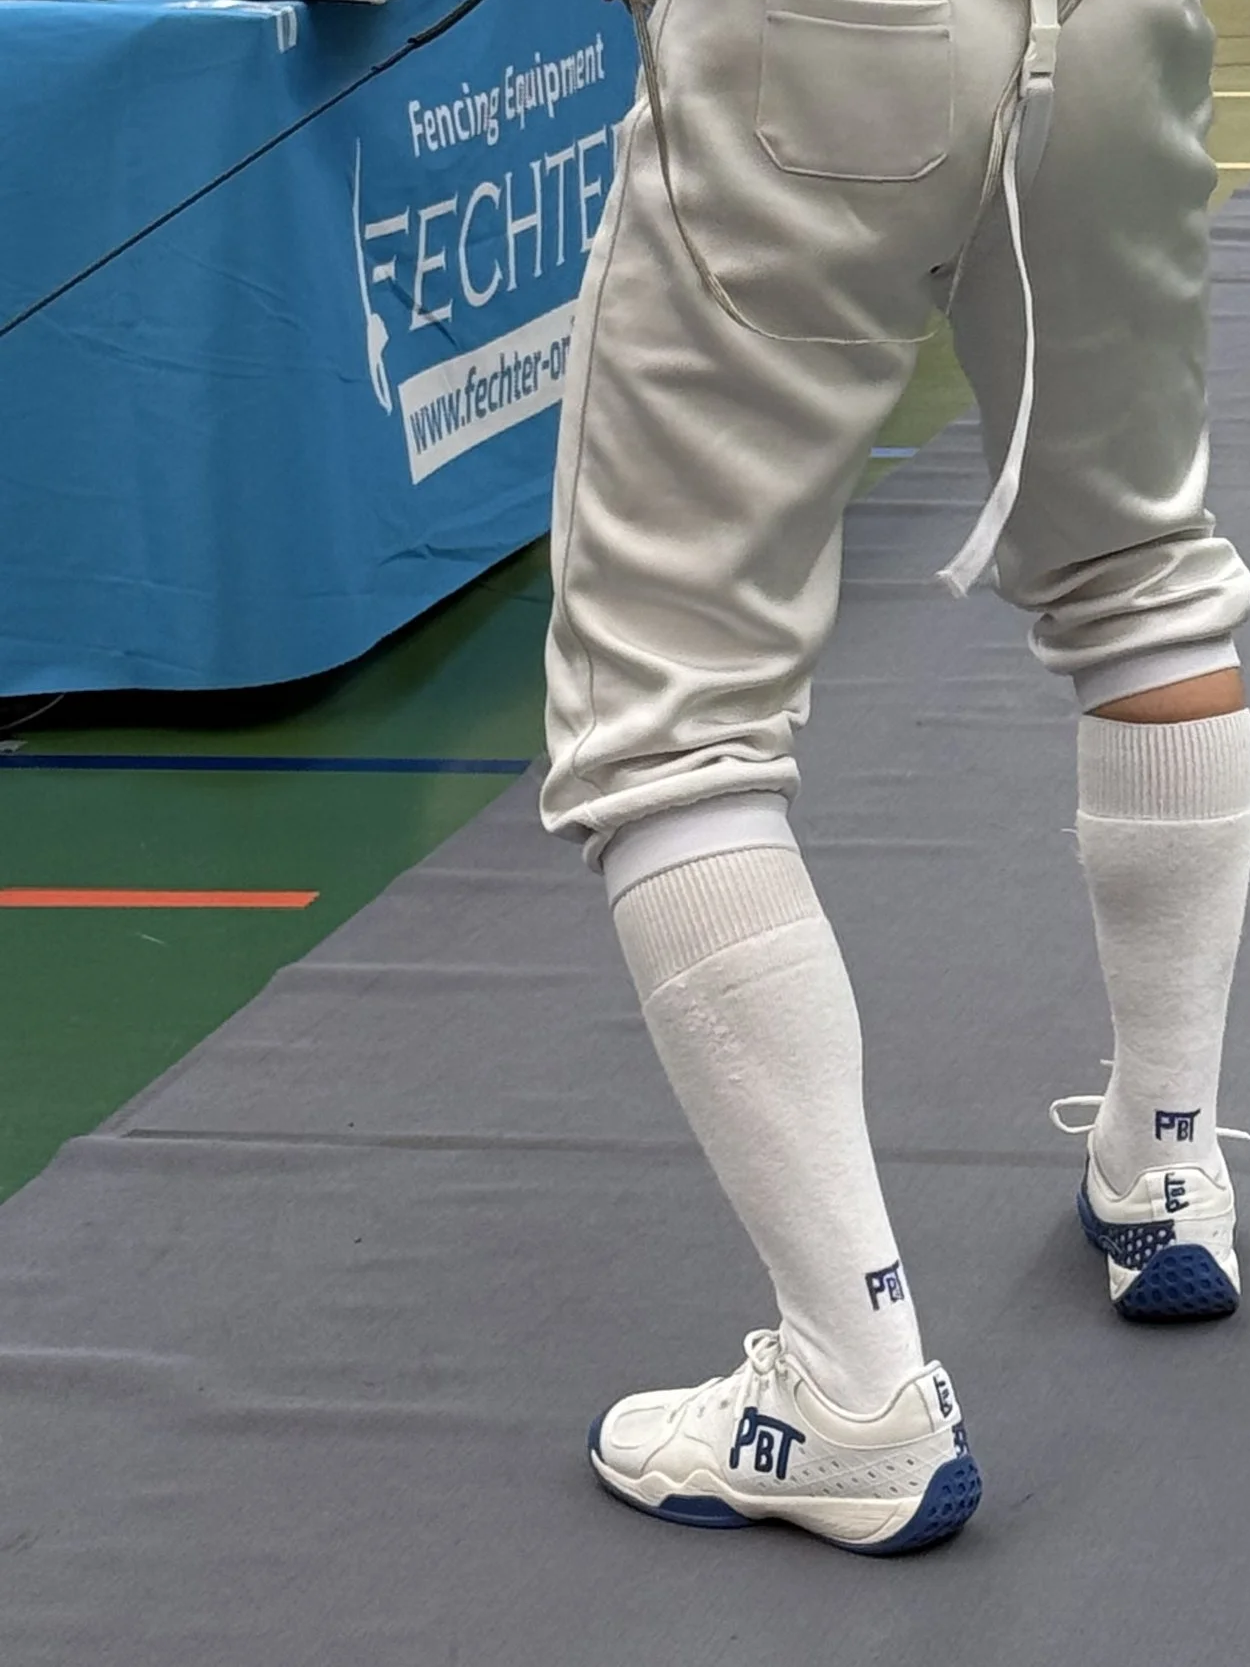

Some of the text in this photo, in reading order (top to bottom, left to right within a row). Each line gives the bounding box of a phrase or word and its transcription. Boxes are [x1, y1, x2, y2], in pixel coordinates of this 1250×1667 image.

[408, 32, 606, 158] Fencing Equipment
[362, 122, 622, 332] FECHTE
[1155, 1108, 1201, 1142] PBT
[865, 1259, 905, 1311] PBT
[729, 1406, 806, 1480] PBT
